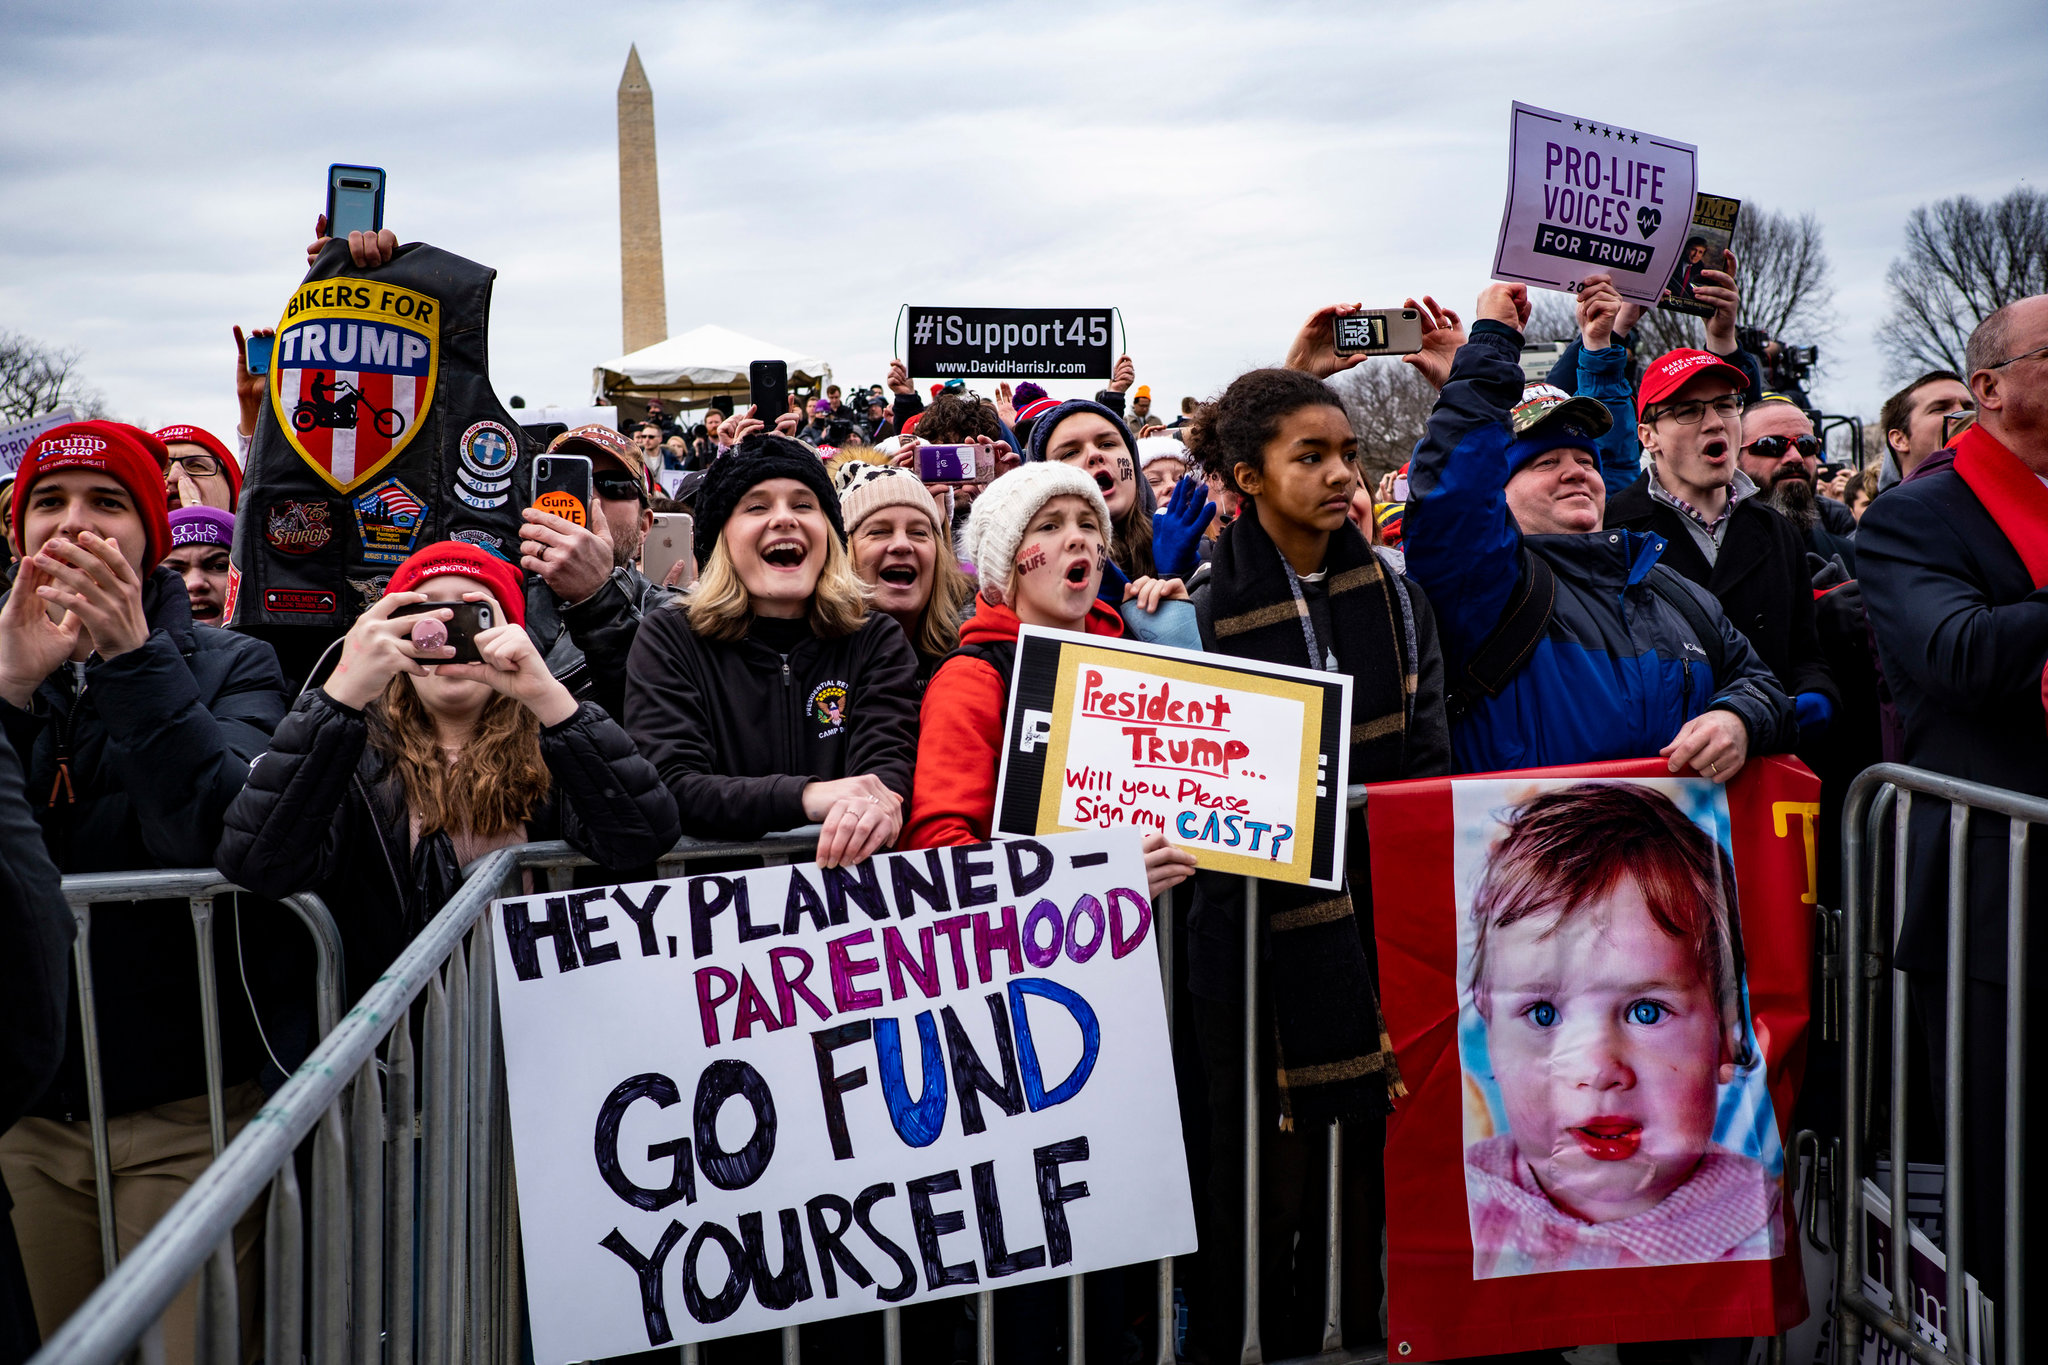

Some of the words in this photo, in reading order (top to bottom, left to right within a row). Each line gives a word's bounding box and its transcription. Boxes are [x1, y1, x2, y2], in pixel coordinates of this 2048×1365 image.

[1546, 141, 1666, 205] PRO-LIFE
[1544, 184, 1631, 236] VOICES
[1542, 231, 1582, 253] FOR
[1589, 240, 1648, 268] TRUMP
[1567, 280, 1585, 294] 20
[288, 286, 371, 318] BIKERS
[380, 291, 433, 324] FOR
[913, 315, 1108, 354] #iSupport45
[1344, 319, 1358, 346] LIFE
[1356, 318, 1370, 347] PRO
[282, 324, 428, 368] TRUMP
[936, 360, 1086, 374] www.DavidHarrisJr.com
[1661, 358, 1684, 374] MAKE
[1669, 361, 1693, 376] GREAT
[468, 424, 480, 435] RIDE
[563, 427, 626, 446] Trump
[38, 437, 107, 454] Trump
[62, 447, 93, 456] 2020
[1117, 458, 1132, 468] PRO-
[1120, 468, 1133, 481] LIFE
[468, 478, 497, 491] 2017
[464, 495, 495, 508] 2018
[541, 496, 575, 507] Guns
[171, 523, 218, 536] OCUS
[271, 527, 332, 546] STURGIS
[412, 518, 424, 537] POLICE
[172, 533, 217, 546] FAMILY
[1016, 543, 1041, 563] HOOSE
[1026, 552, 1047, 572] LIFE
[806, 680, 836, 717] PRESIDENTIAL
[1082, 670, 1231, 728] President
[818, 727, 839, 739] CAMP
[1066, 765, 1112, 792] Will
[1119, 779, 1170, 806] you
[1178, 778, 1250, 815] Please
[1074, 795, 1124, 829] Sign
[1131, 808, 1166, 837] my
[1176, 810, 1293, 861] CAST?
[502, 884, 678, 982] HEY,
[694, 887, 1152, 1048] PARENTHOOD
[595, 1059, 777, 1211] GO
[810, 977, 1101, 1160] FUND
[600, 1136, 1091, 1346] YOURSELF
